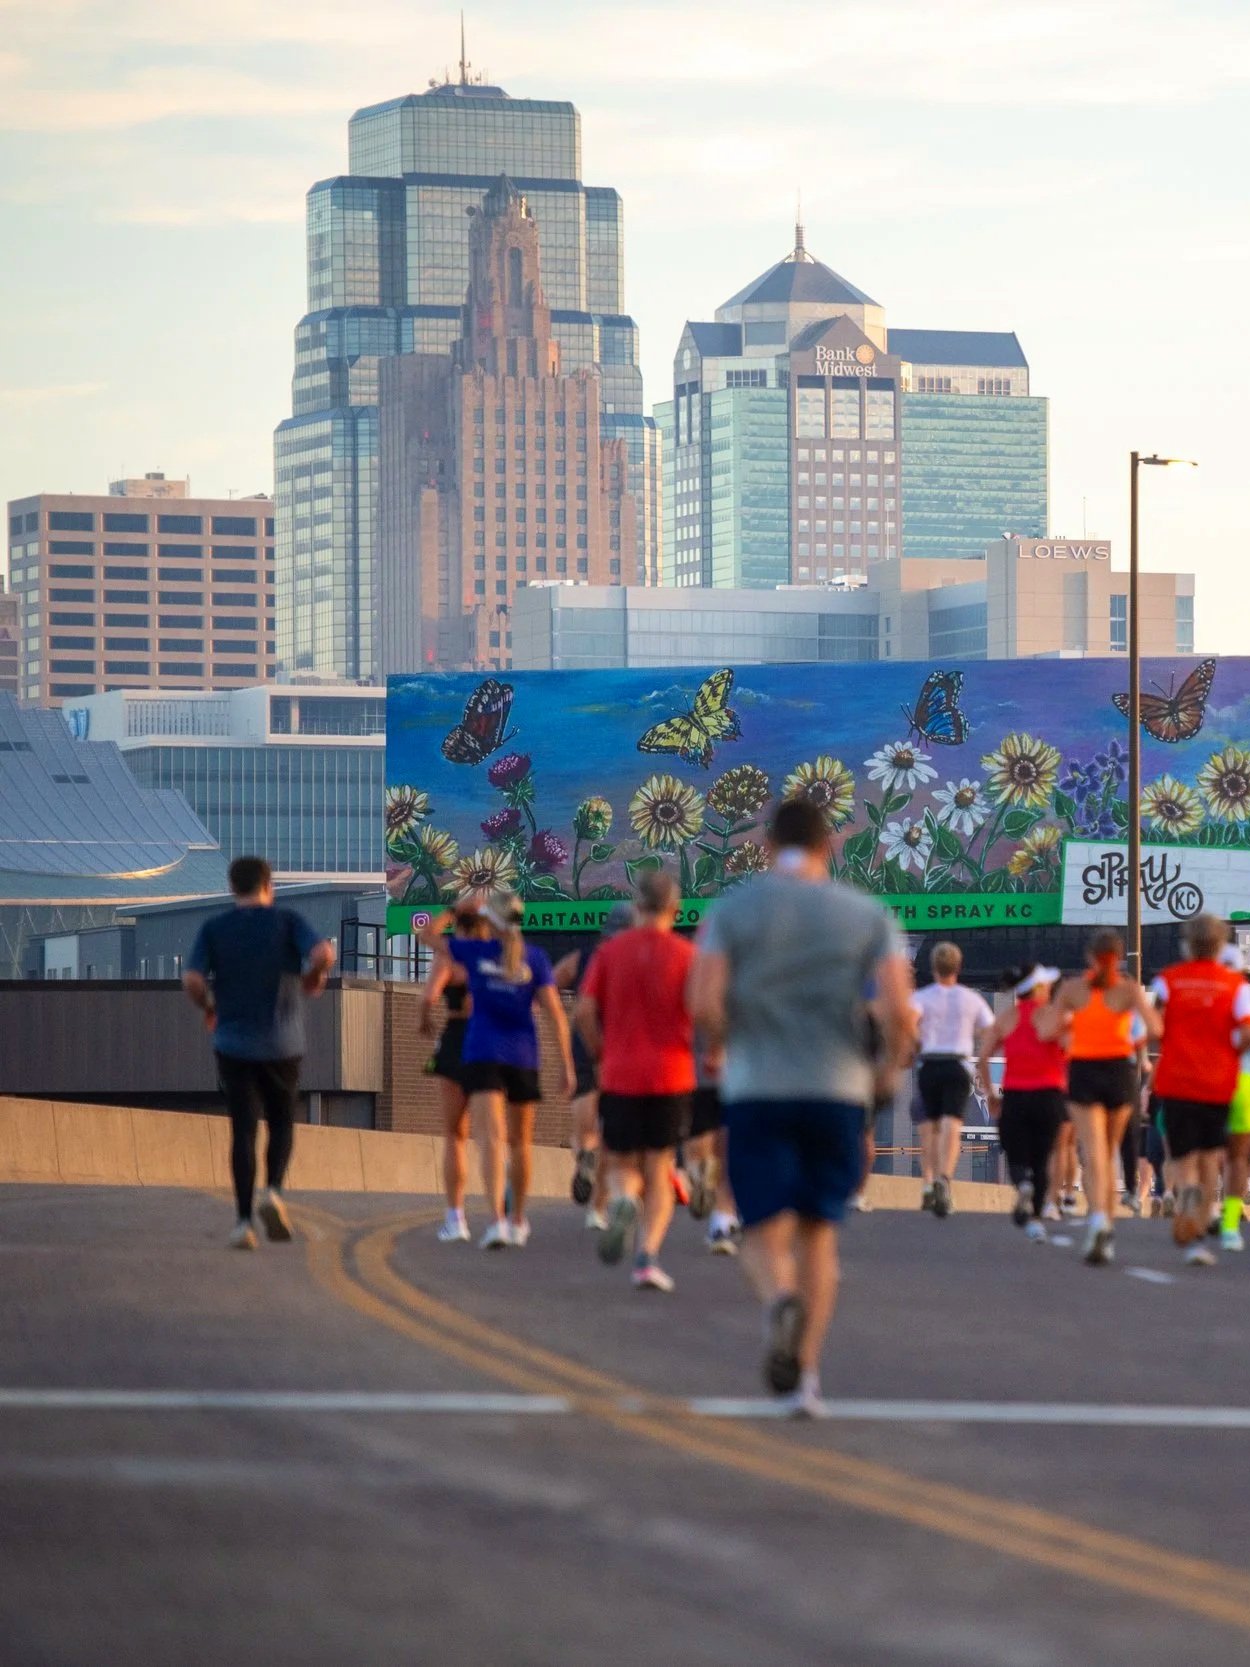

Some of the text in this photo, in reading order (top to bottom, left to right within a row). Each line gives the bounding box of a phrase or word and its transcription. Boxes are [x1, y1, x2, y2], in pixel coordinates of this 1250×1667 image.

[815, 345, 856, 362] Bank
[815, 361, 878, 377] Midwest
[1018, 544, 1110, 560] LOEWS
[1174, 891, 1197, 911] KC
[927, 904, 995, 919] SPRAY
[1005, 904, 1033, 918] KC
